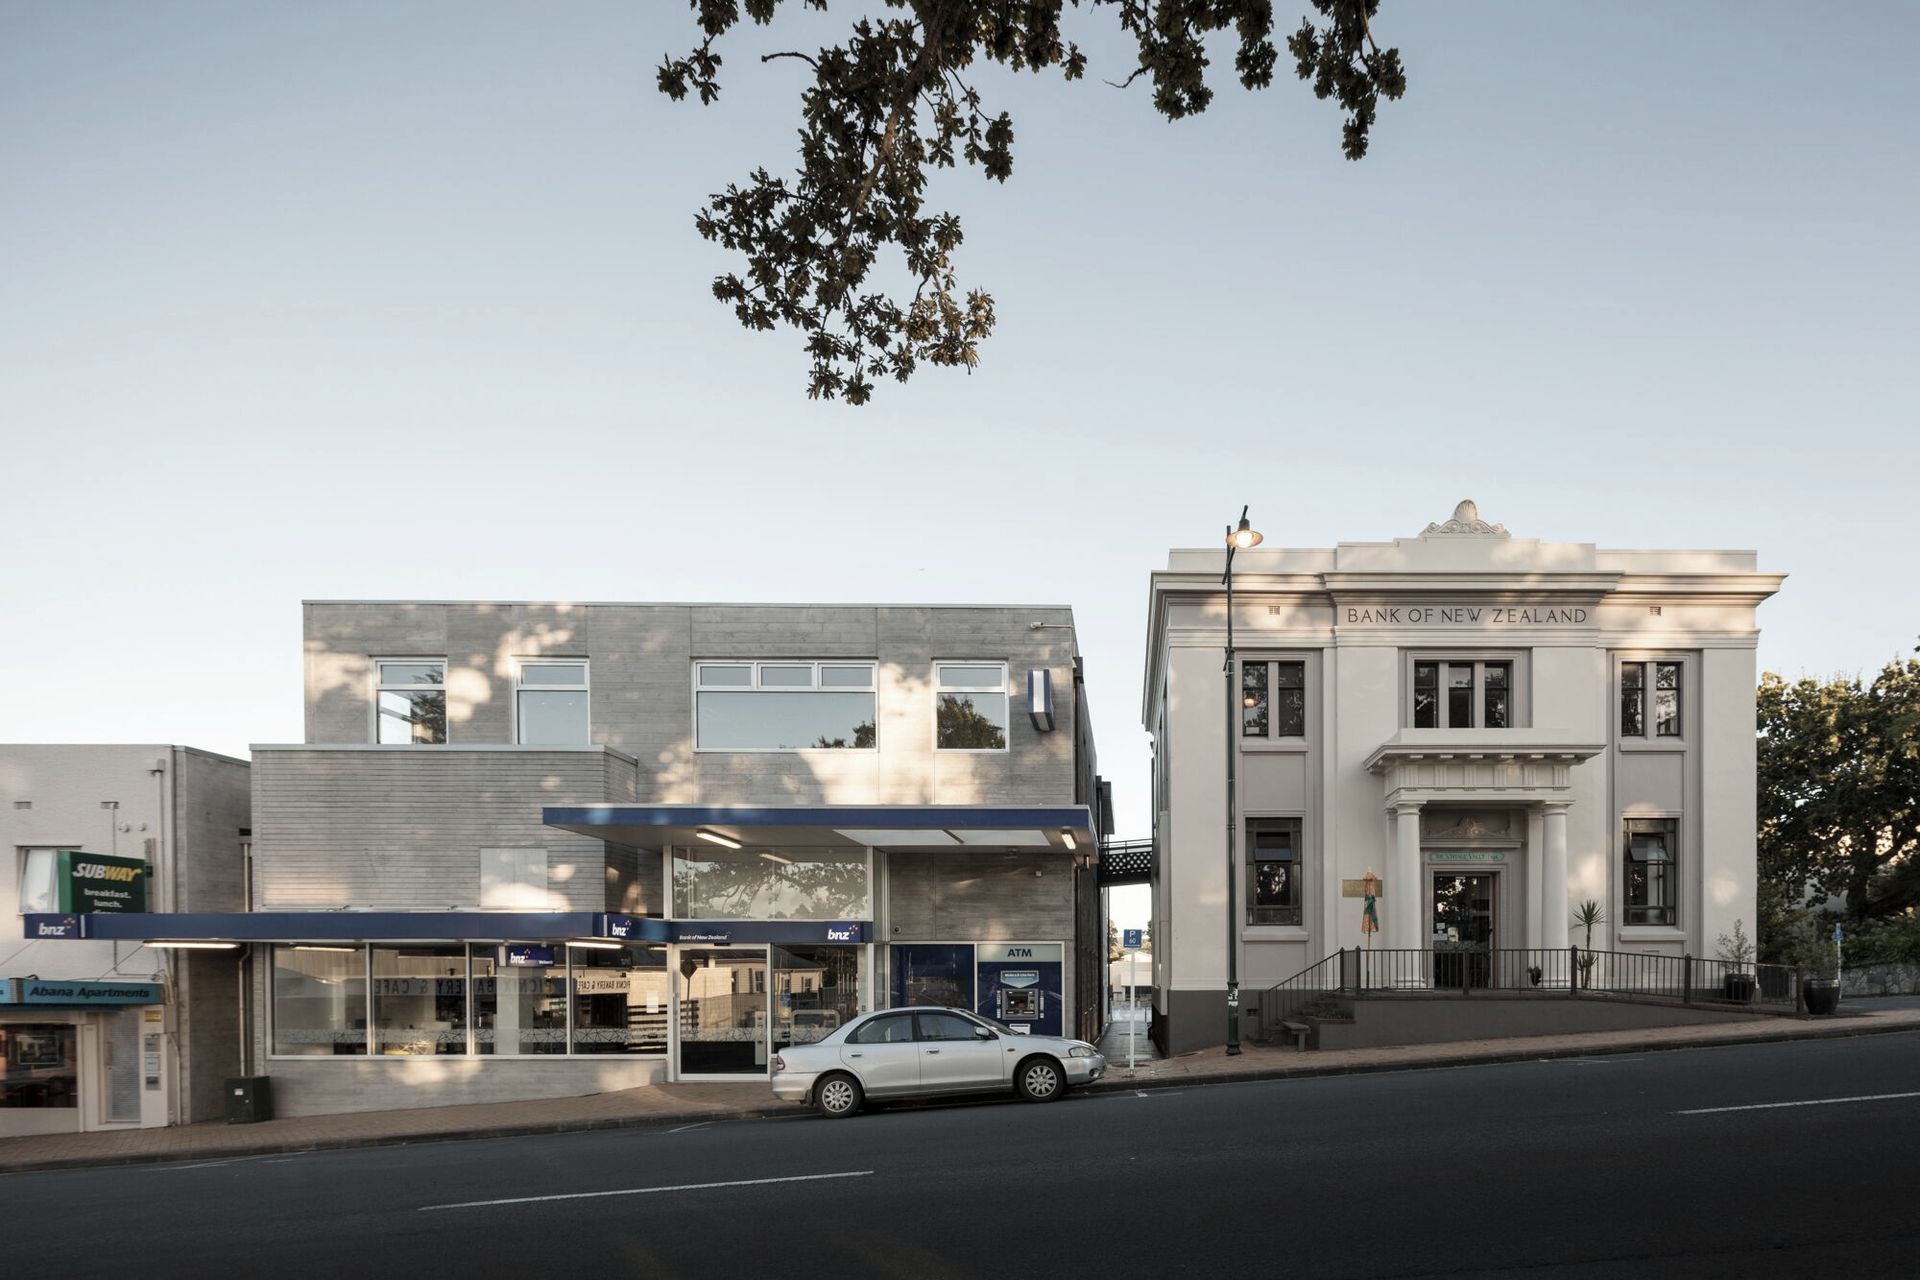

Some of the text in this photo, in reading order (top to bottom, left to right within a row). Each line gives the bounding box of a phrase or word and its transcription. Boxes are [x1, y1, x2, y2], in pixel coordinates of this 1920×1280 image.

[1347, 608, 1587, 623] BANK OF NEW ZEALAND
[72, 862, 143, 882] SUBWAY
[83, 888, 132, 899] breakfast.
[38, 922, 65, 935] bnz
[612, 922, 627, 937] bnz
[827, 928, 850, 941] bnz
[1007, 948, 1032, 958] ATM
[29, 986, 150, 999] Abana Apartments
